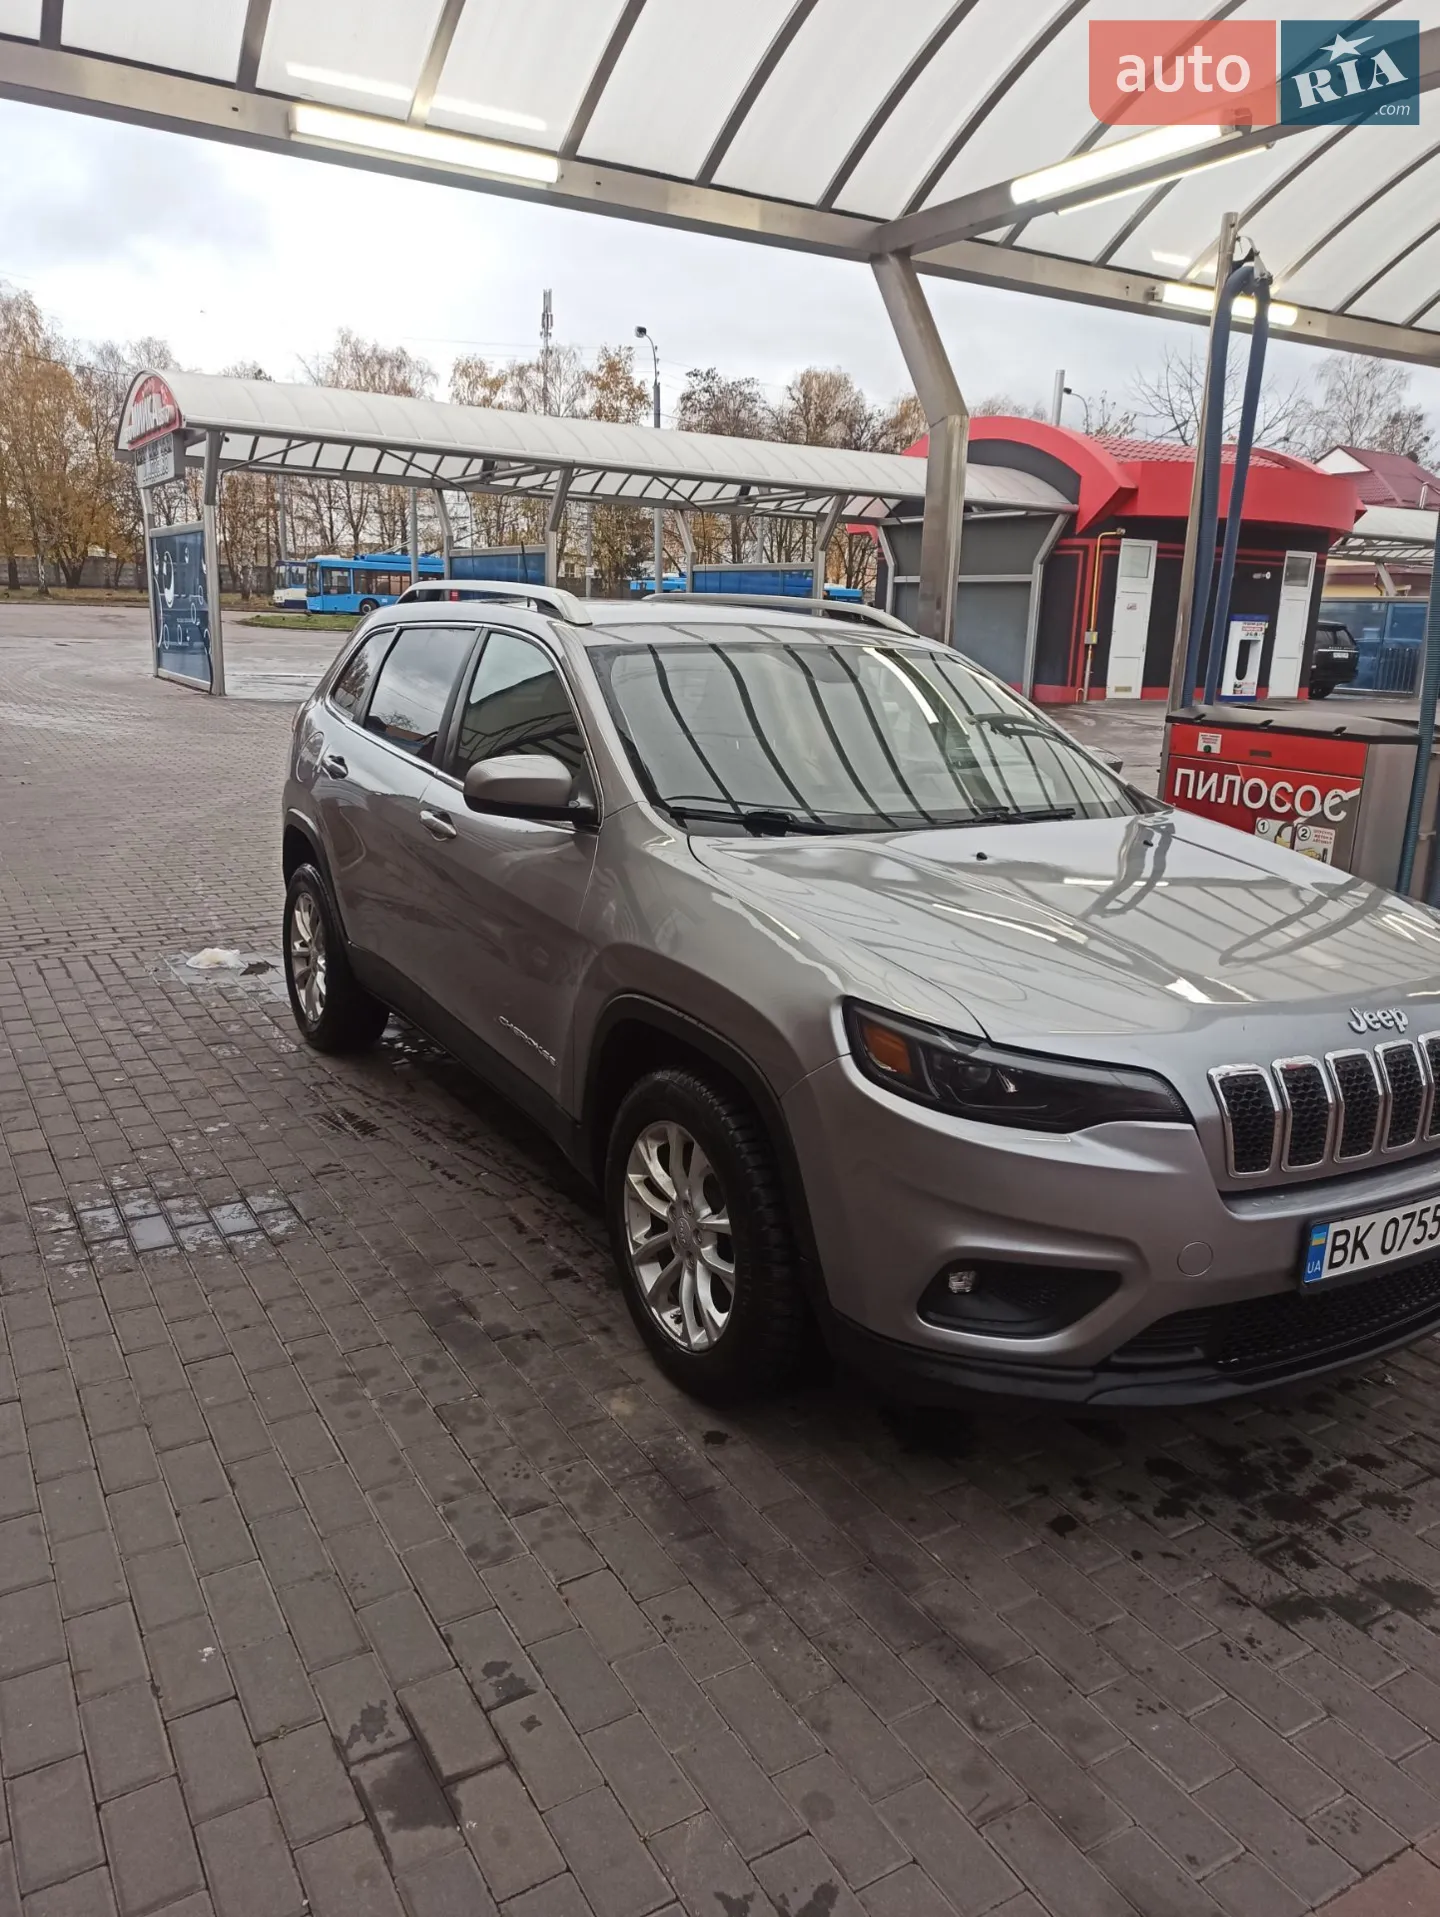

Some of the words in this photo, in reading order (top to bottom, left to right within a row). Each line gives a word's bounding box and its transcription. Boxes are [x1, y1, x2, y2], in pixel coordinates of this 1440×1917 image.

[1174, 768, 1348, 822] ПИЛОСОС
[1348, 1007, 1409, 1033] Jeep
[1327, 1221, 1377, 1271] BK
[1380, 1203, 1440, 1256] 0755
[1307, 1260, 1321, 1274] UA
